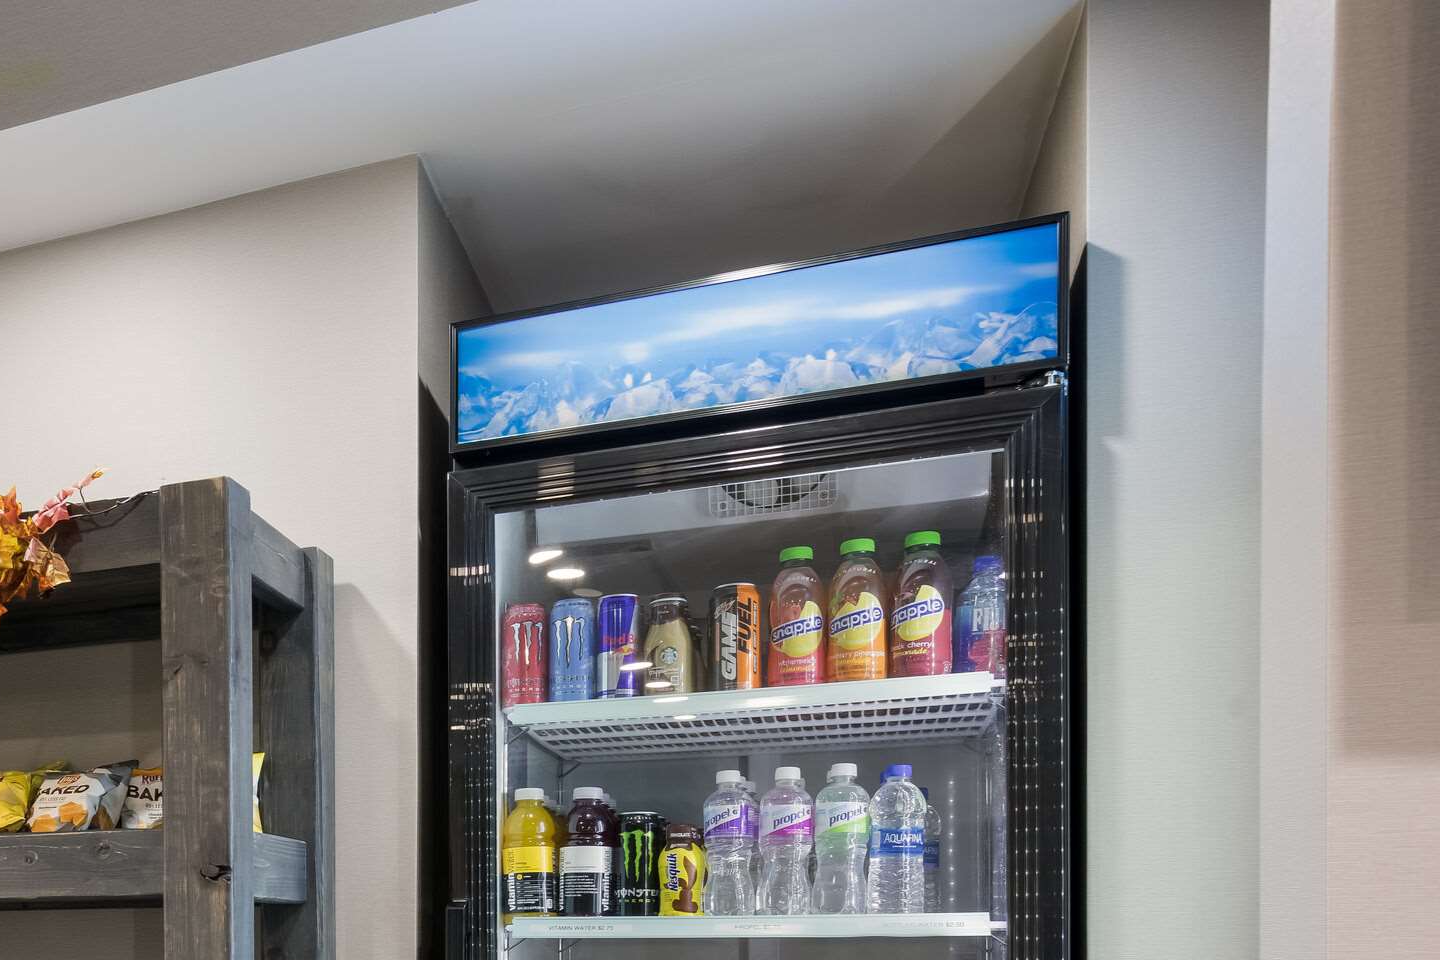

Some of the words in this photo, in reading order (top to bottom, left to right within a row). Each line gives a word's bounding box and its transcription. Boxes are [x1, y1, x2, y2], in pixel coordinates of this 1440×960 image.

[831, 606, 882, 634] snapple
[891, 598, 943, 625] napple
[737, 597, 753, 655] FUEL
[772, 616, 822, 641] snapple
[721, 611, 737, 681] GAME
[127, 784, 163, 801] BAK
[773, 809, 806, 830] propel
[829, 808, 864, 828] propel
[666, 852, 679, 892] Nesquik
